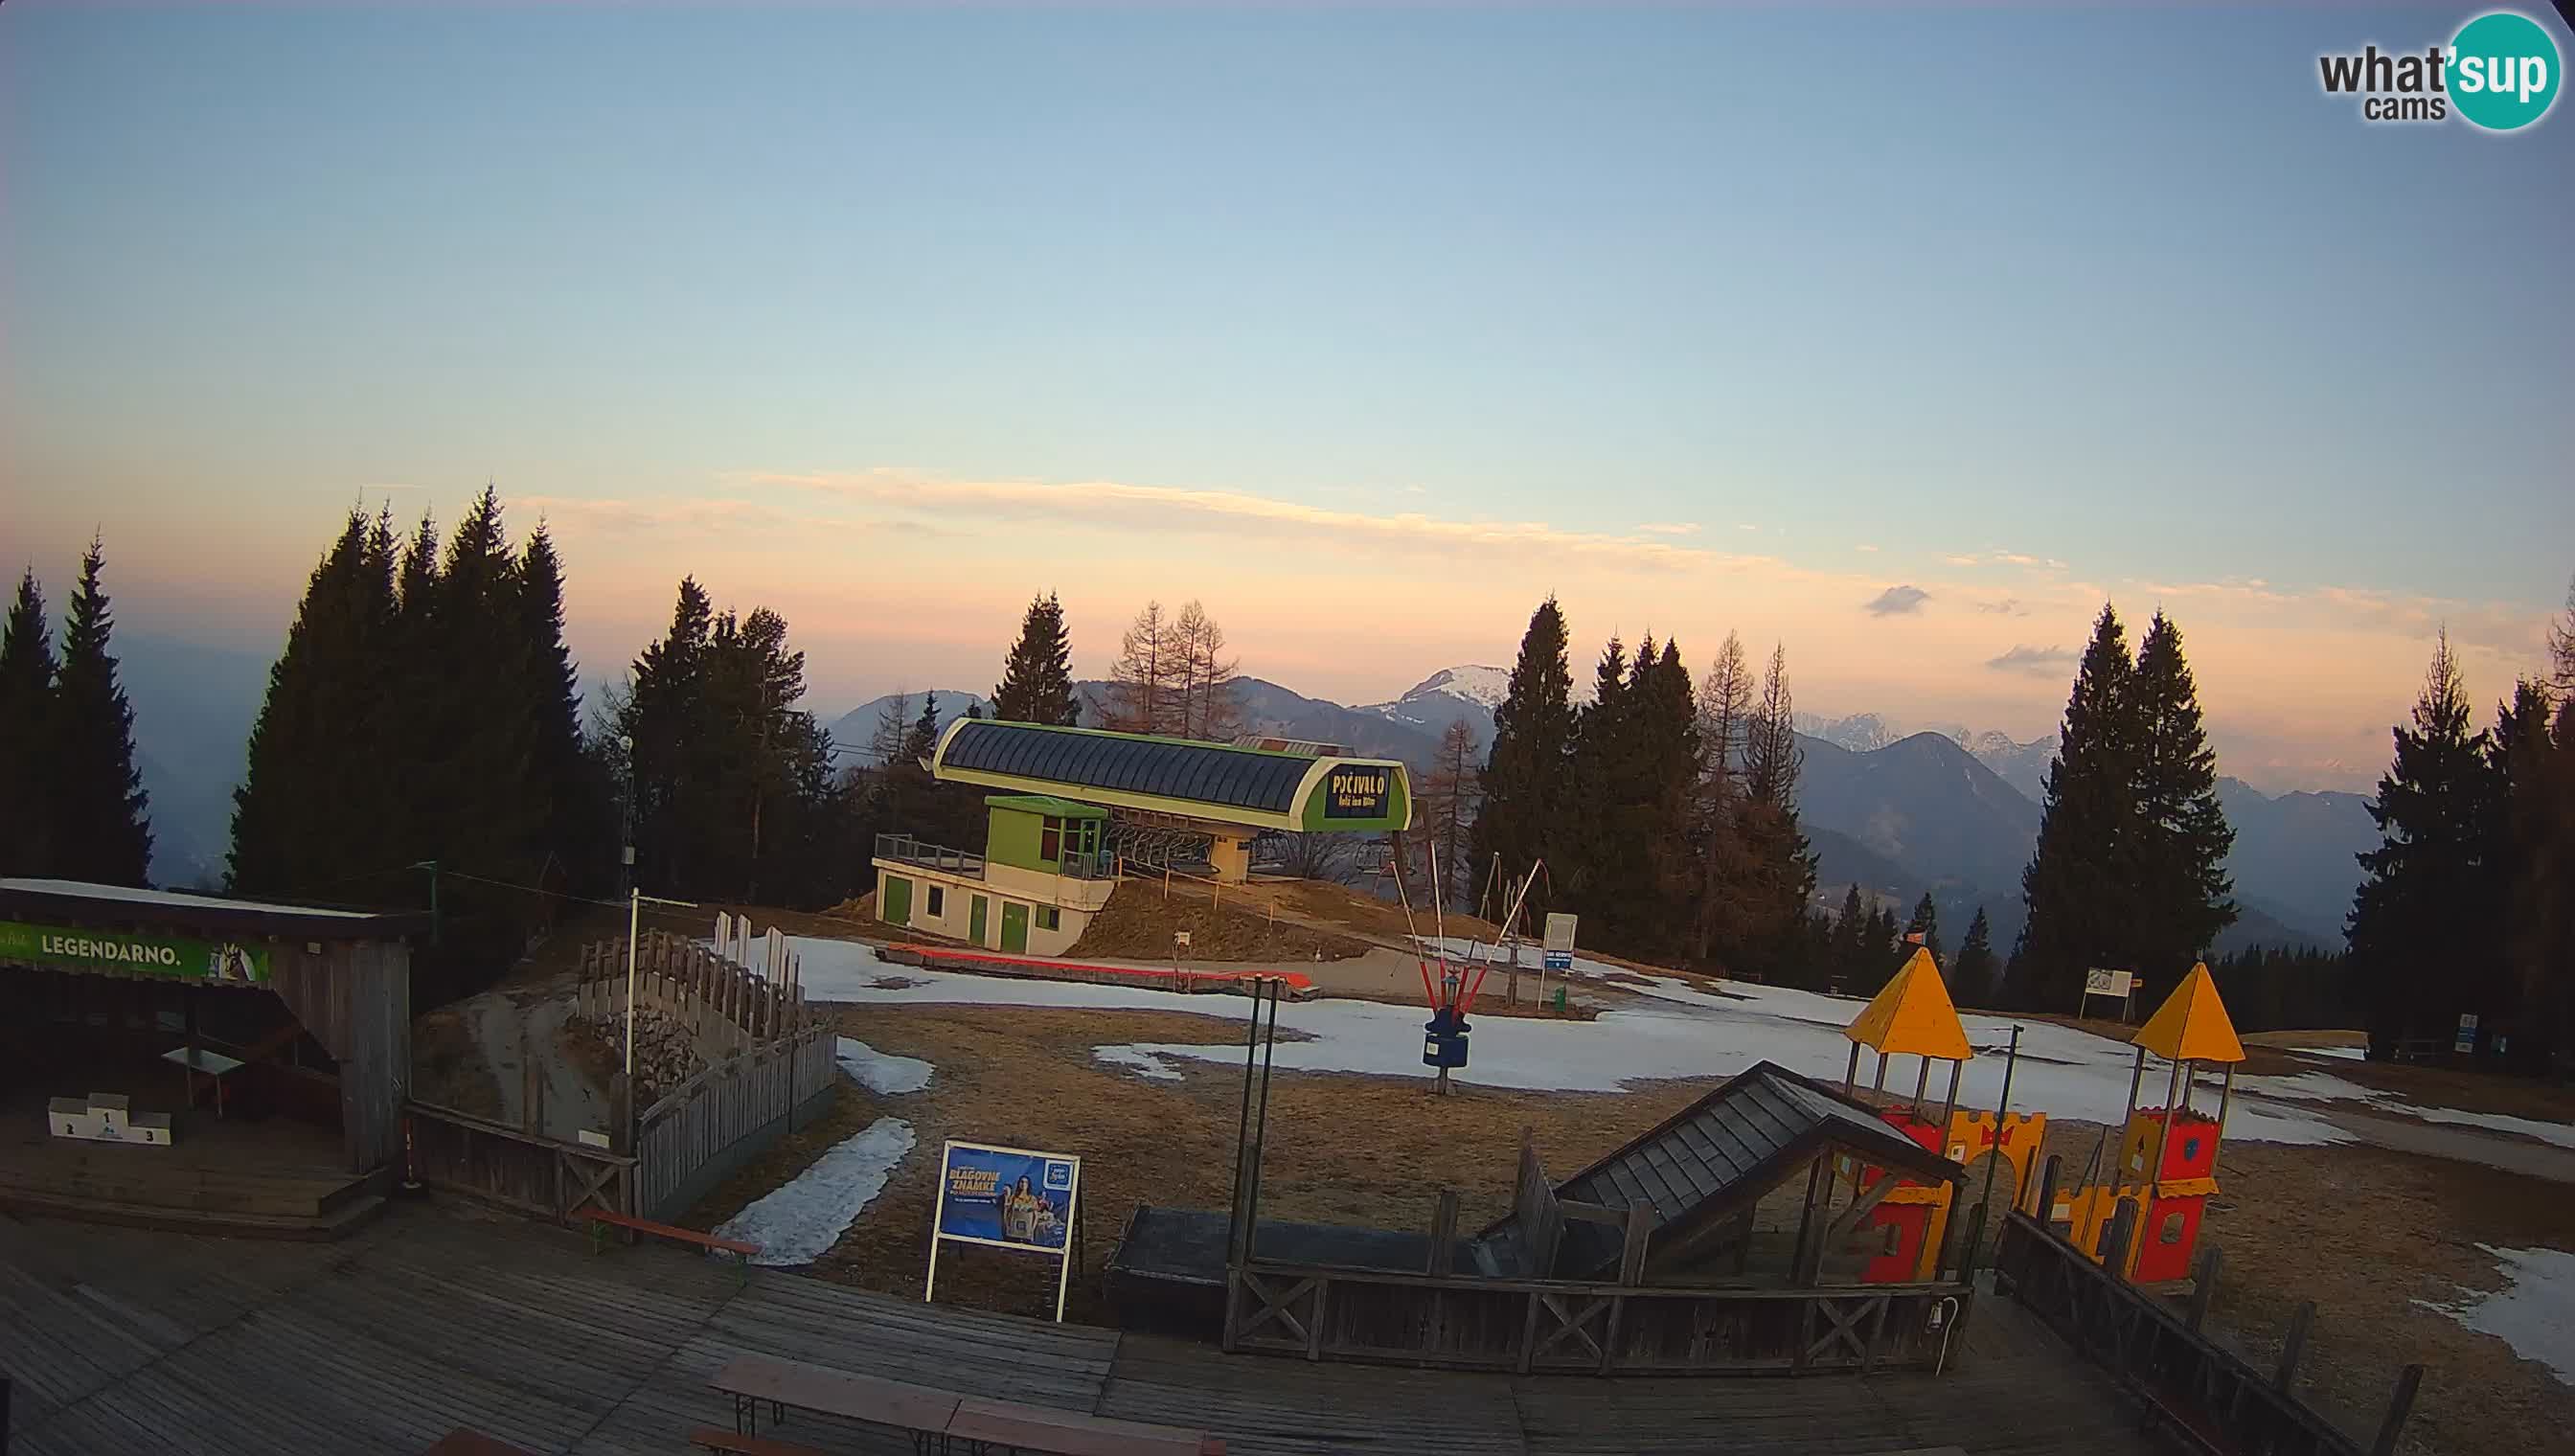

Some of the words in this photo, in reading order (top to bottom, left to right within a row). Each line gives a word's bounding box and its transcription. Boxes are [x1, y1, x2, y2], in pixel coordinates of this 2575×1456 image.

[42, 935, 181, 967] LEGENDARNO.
[103, 1112, 110, 1124] 1
[66, 1124, 74, 1134] 2
[146, 1130, 154, 1142] 3
[952, 1180, 995, 1191] ZNAMKE
